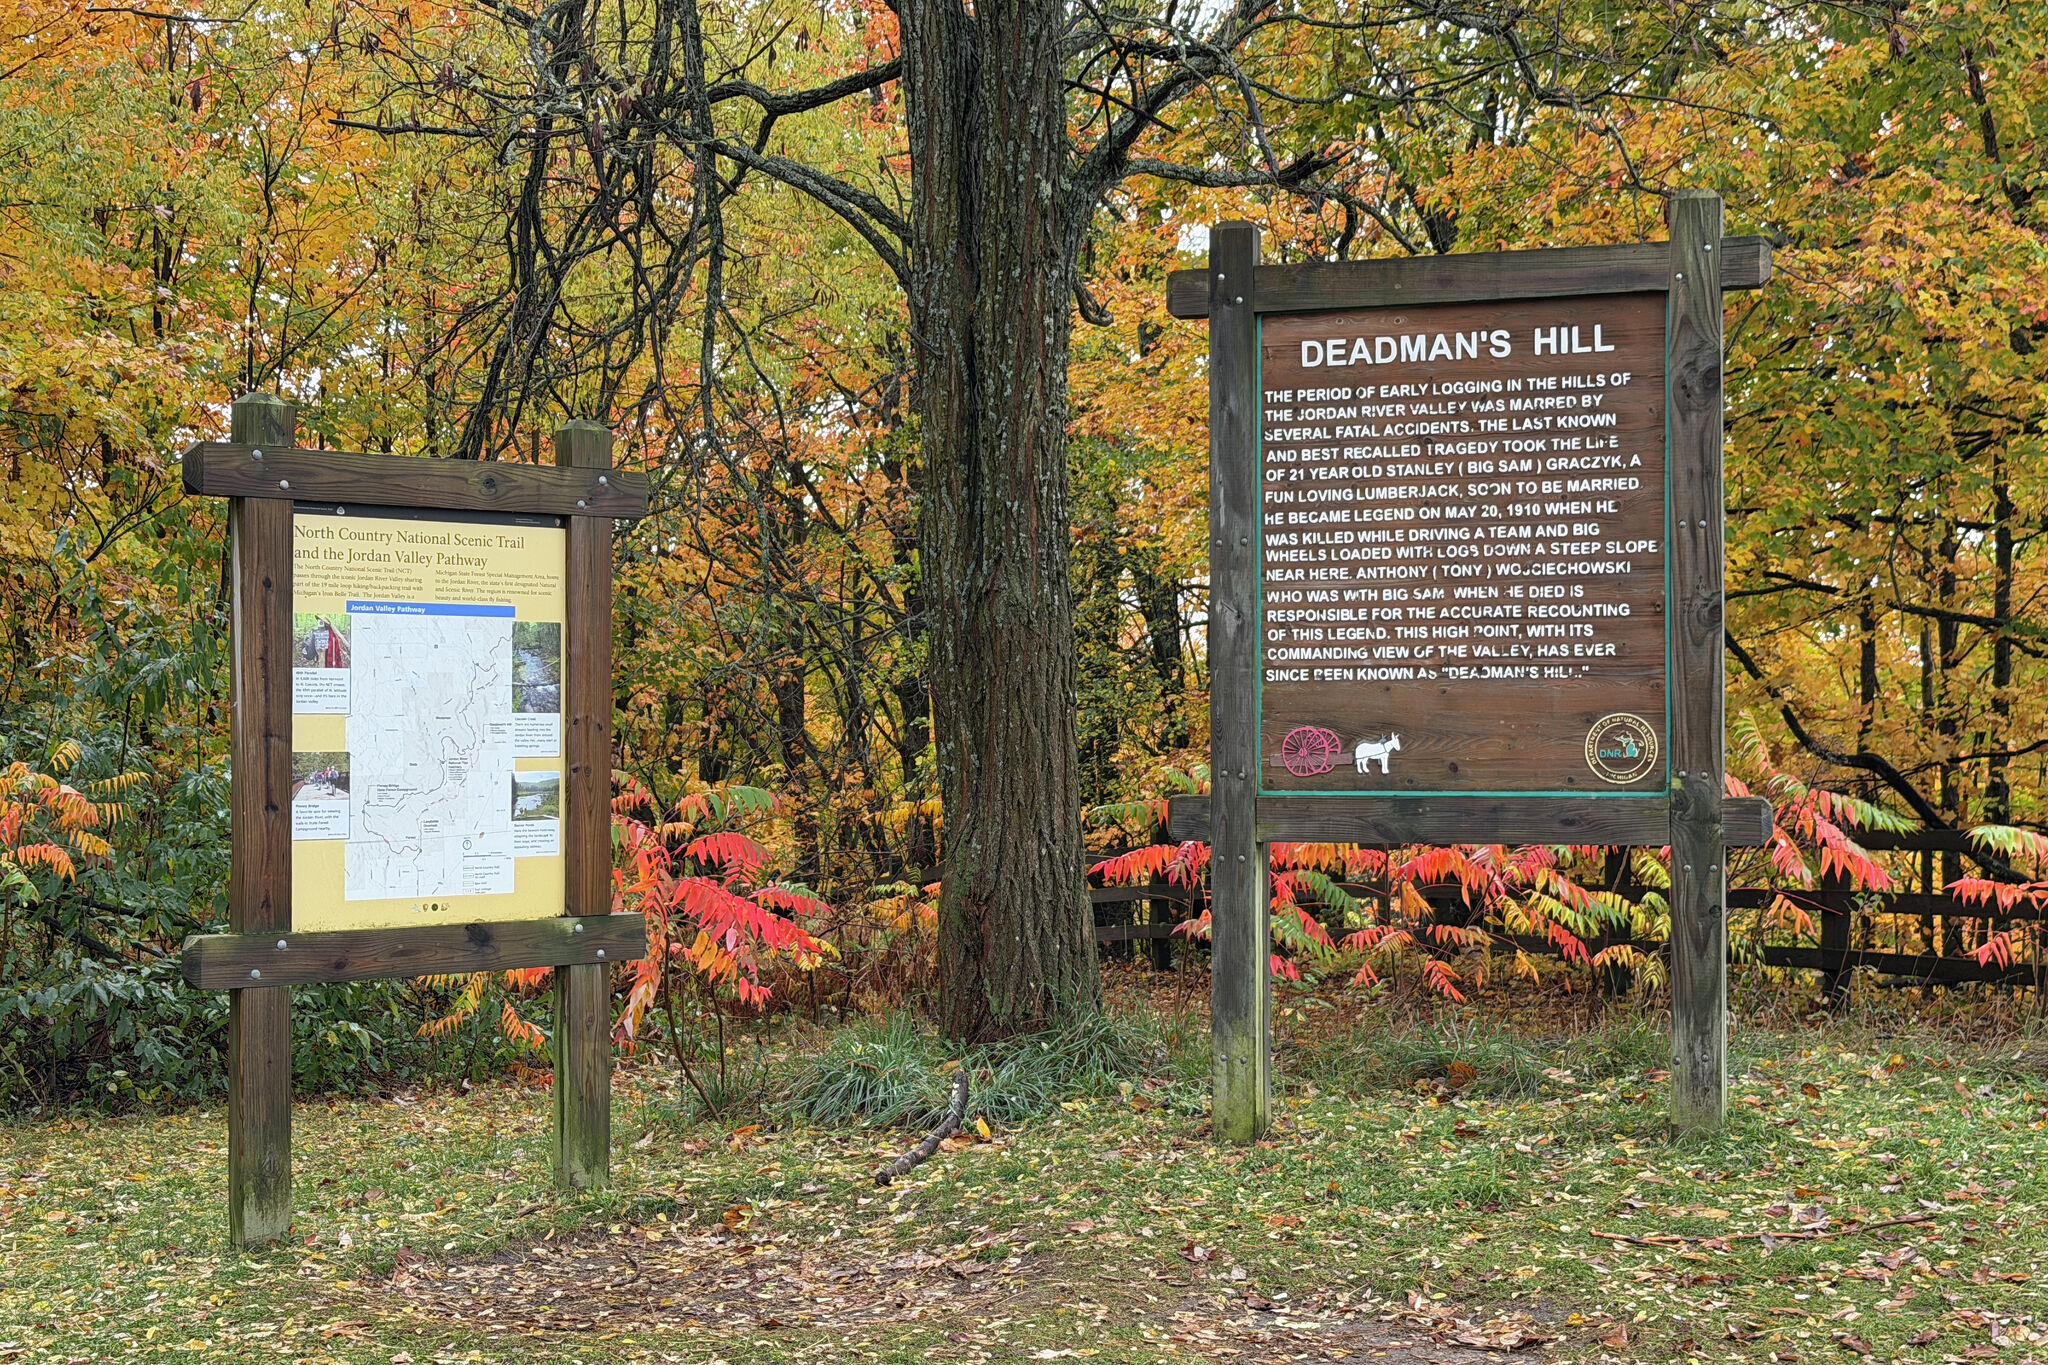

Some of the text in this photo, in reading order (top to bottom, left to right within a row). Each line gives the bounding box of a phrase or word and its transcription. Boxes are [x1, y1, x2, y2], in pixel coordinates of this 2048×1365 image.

[1301, 324, 1615, 368] DEADMAN'S HILL
[1264, 372, 1631, 404] THE PERIOD OF EARLY LOGGING IN THE HILLS OF
[1264, 393, 1604, 422] THE JORDAN RIVER VALLEY WAS MARRED BY
[1264, 412, 1617, 442] SEVERAL FATAL ACCIDENTS. THE LAST KNOWN
[1266, 435, 1619, 463] AND BEST RECALLED TRAGEDY TOOK THE LIFE
[1265, 468, 1286, 482] OF
[1289, 468, 1304, 481] 21
[1309, 466, 1349, 480] YEAR
[1351, 464, 1383, 479] OLD
[1385, 461, 1455, 478] STANLEY
[1467, 460, 1494, 474] BIG
[1498, 458, 1533, 473] SAM
[1545, 454, 1627, 471] GRACZYK,
[1629, 453, 1642, 467] A
[1264, 490, 1294, 504] FUN
[1298, 488, 1354, 503] LOVING
[1356, 484, 1463, 501] LUMBERJACK,
[1467, 482, 1512, 497] SOON
[1515, 481, 1538, 495] TO
[1541, 480, 1563, 494] BE
[1264, 499, 1619, 526] HE BECAME LEGEND ON MAY 20, 1910 WHEN HE
[294, 524, 525, 549] North Country National Scenic Trail
[1265, 522, 1600, 547] WAS KILLED WHILE DRIVING A TEAM AND BIG
[294, 546, 488, 570] and the Jordan Valley Pathway
[1265, 539, 1658, 563] WHEELS LOADED WITH LOGS DOWN A STEEP SLOPE
[310, 573, 331, 581] through
[357, 574, 374, 582] Jordan
[388, 575, 403, 583] Valley
[321, 564, 343, 572] Country
[395, 567, 413, 575] (NCT)
[1266, 568, 1306, 582] NEAR
[1309, 567, 1353, 582] HERE.
[1355, 565, 1429, 580] ANTHONY
[1441, 563, 1483, 578] TONY
[1266, 584, 1584, 604] WHO WAS WITH BIG SAM WHEN HE DIED IS
[350, 603, 426, 615] Jordan Valley Pathway
[1266, 603, 1631, 623] RESPONSIBLE FOR THE ACCURATE RECOUNTING
[1267, 623, 1594, 642] OF THIS LEGEND. THIS HIGH POINT, WITH ITS
[1267, 642, 1616, 661] COMMANDING VIEW OF THE VALLEY, HAS EVER
[1265, 668, 1310, 682] SINCE
[1313, 668, 1354, 681] BEEN
[1356, 667, 1414, 681] KNOWN
[1416, 667, 1438, 680] AS
[1599, 749, 1622, 758] DNR
